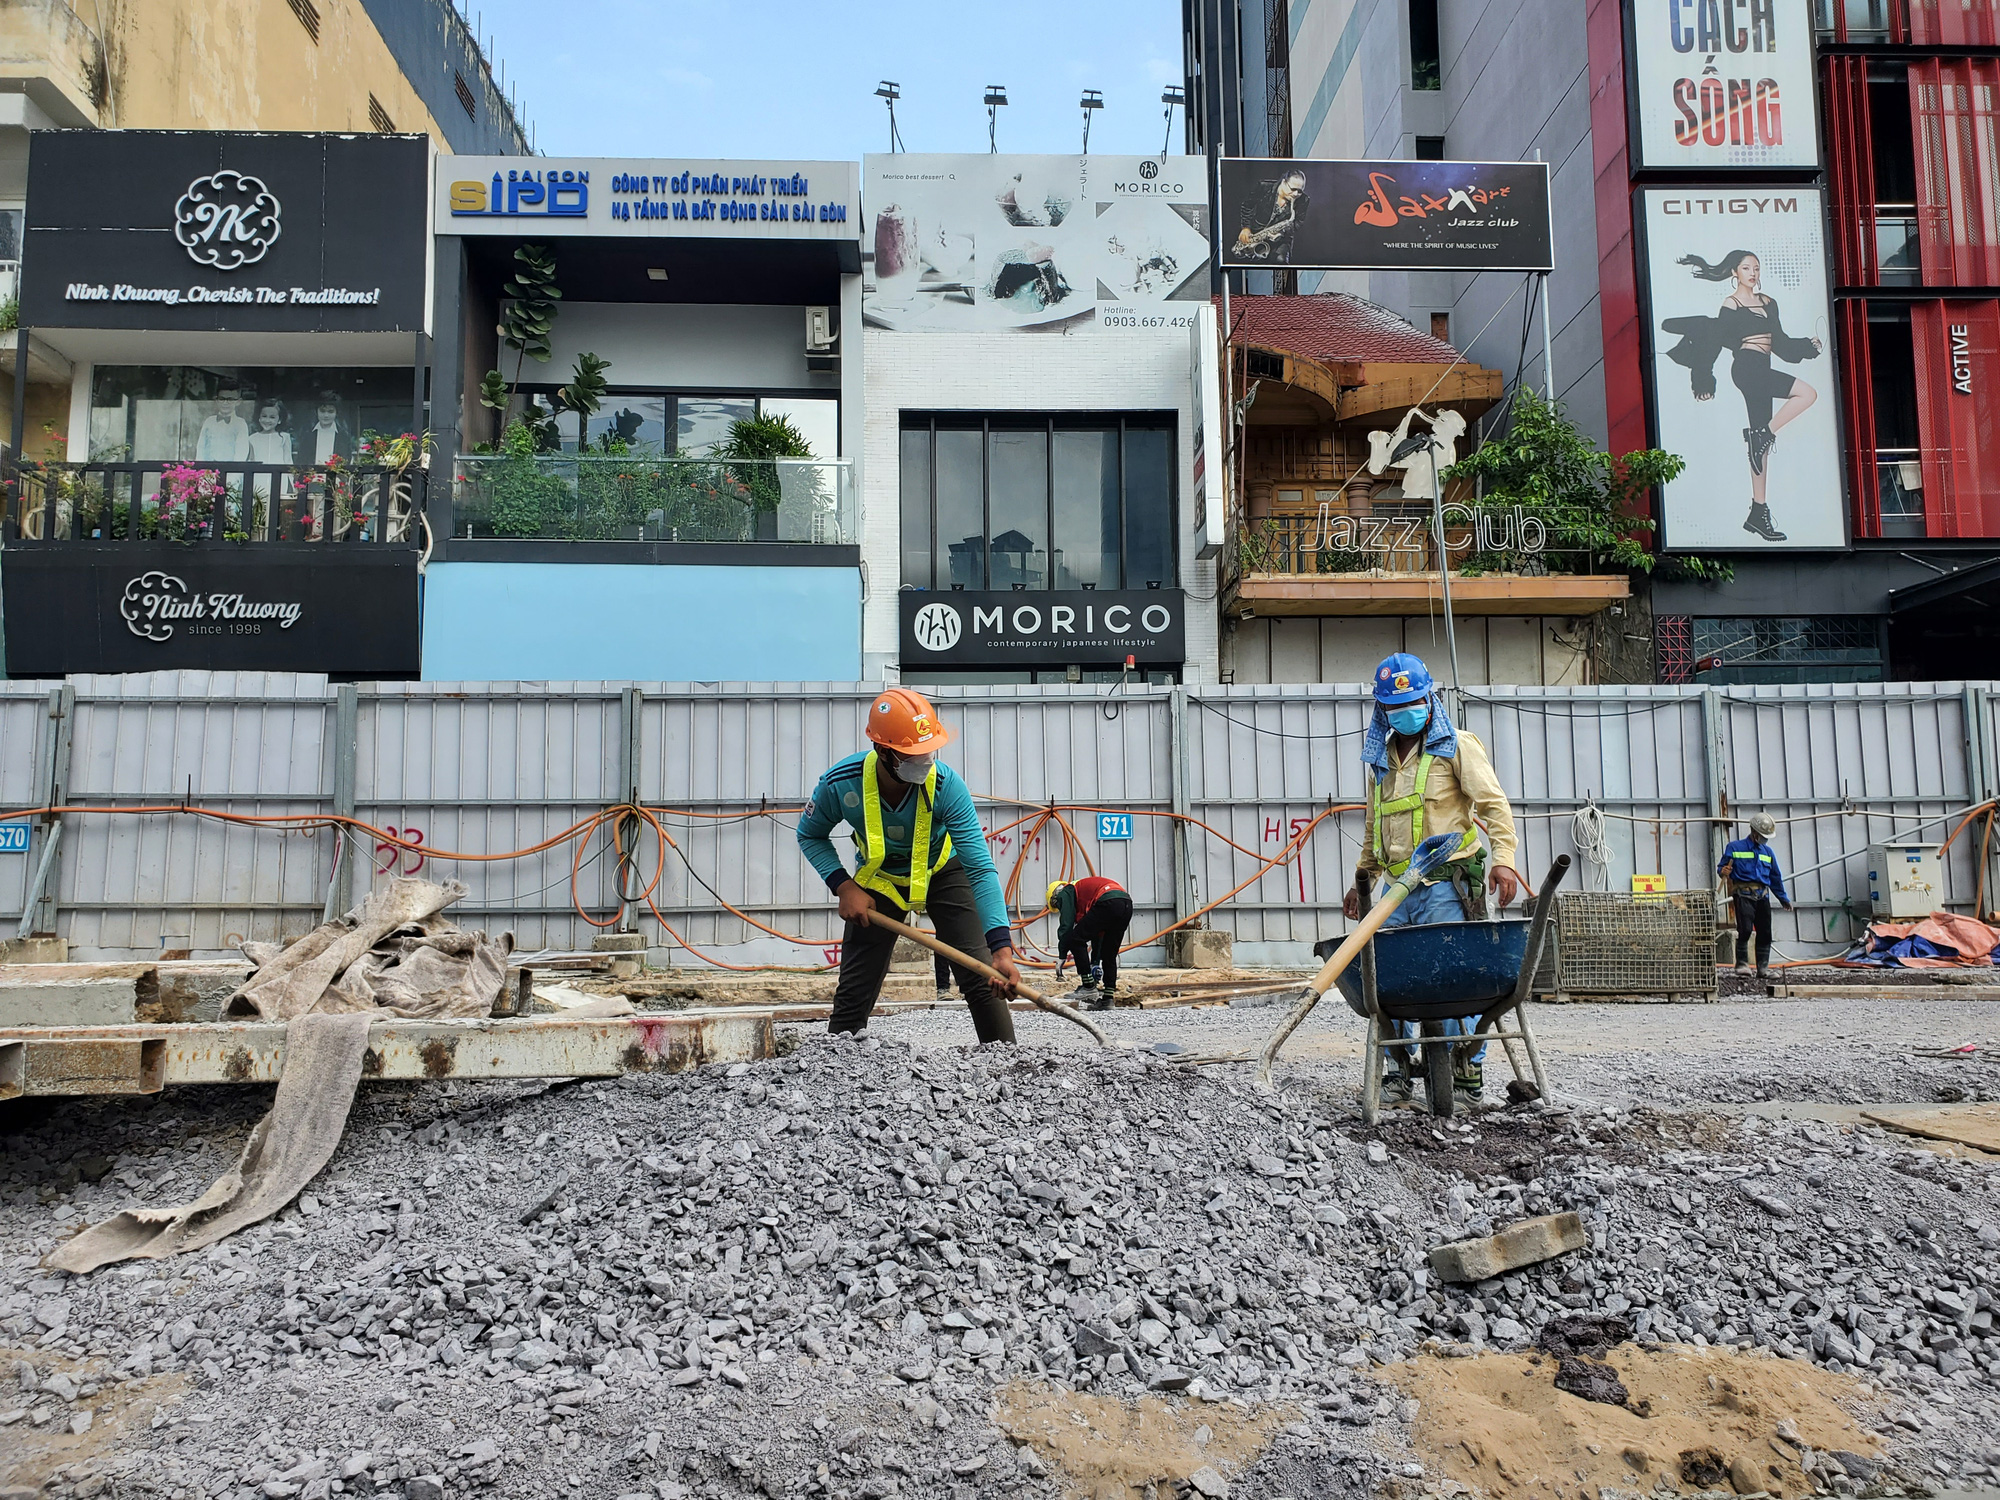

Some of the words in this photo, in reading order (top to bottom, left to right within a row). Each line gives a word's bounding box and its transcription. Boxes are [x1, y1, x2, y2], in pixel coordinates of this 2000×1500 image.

[1673, 55, 1783, 147] SỐNG
[508, 170, 589, 183] SAIGON
[612, 172, 649, 193] CÔNG
[652, 176, 668, 194] TY
[671, 170, 690, 194] CỔ
[733, 174, 767, 196] PHÁT
[771, 172, 808, 196] TRIỂN
[1080, 159, 1088, 201] ジェラート
[450, 171, 588, 213] SIPD
[1114, 182, 1184, 194] MORICO
[612, 201, 630, 222] HẠ
[672, 199, 689, 220] VÀ
[692, 198, 717, 221] BẤT
[720, 200, 757, 223] ĐỘNG
[793, 201, 816, 222] SÀI
[820, 202, 846, 223] GÒN
[1663, 198, 1798, 215] CITIGYM
[1448, 218, 1485, 227] Jazz
[1488, 218, 1519, 227] club
[65, 283, 110, 300] Ninh
[256, 287, 287, 303] The
[290, 287, 380, 305] Traditions!
[1104, 306, 1136, 314] Hotline:
[1104, 316, 1194, 327] 0903.667.426
[1951, 324, 1972, 394] ACTIVE
[1299, 502, 1422, 553] Jazz
[1431, 502, 1547, 553] Club
[142, 593, 208, 621] Ninh
[208, 593, 302, 629] Khuong
[973, 604, 1171, 635] MORICO
[188, 623, 222, 635] since
[228, 623, 261, 635] 1998
[987, 640, 1058, 648] contemporary
[1061, 639, 1109, 648] japanese
[1112, 638, 1156, 647] lifestyle
[1102, 816, 1129, 836] S71
